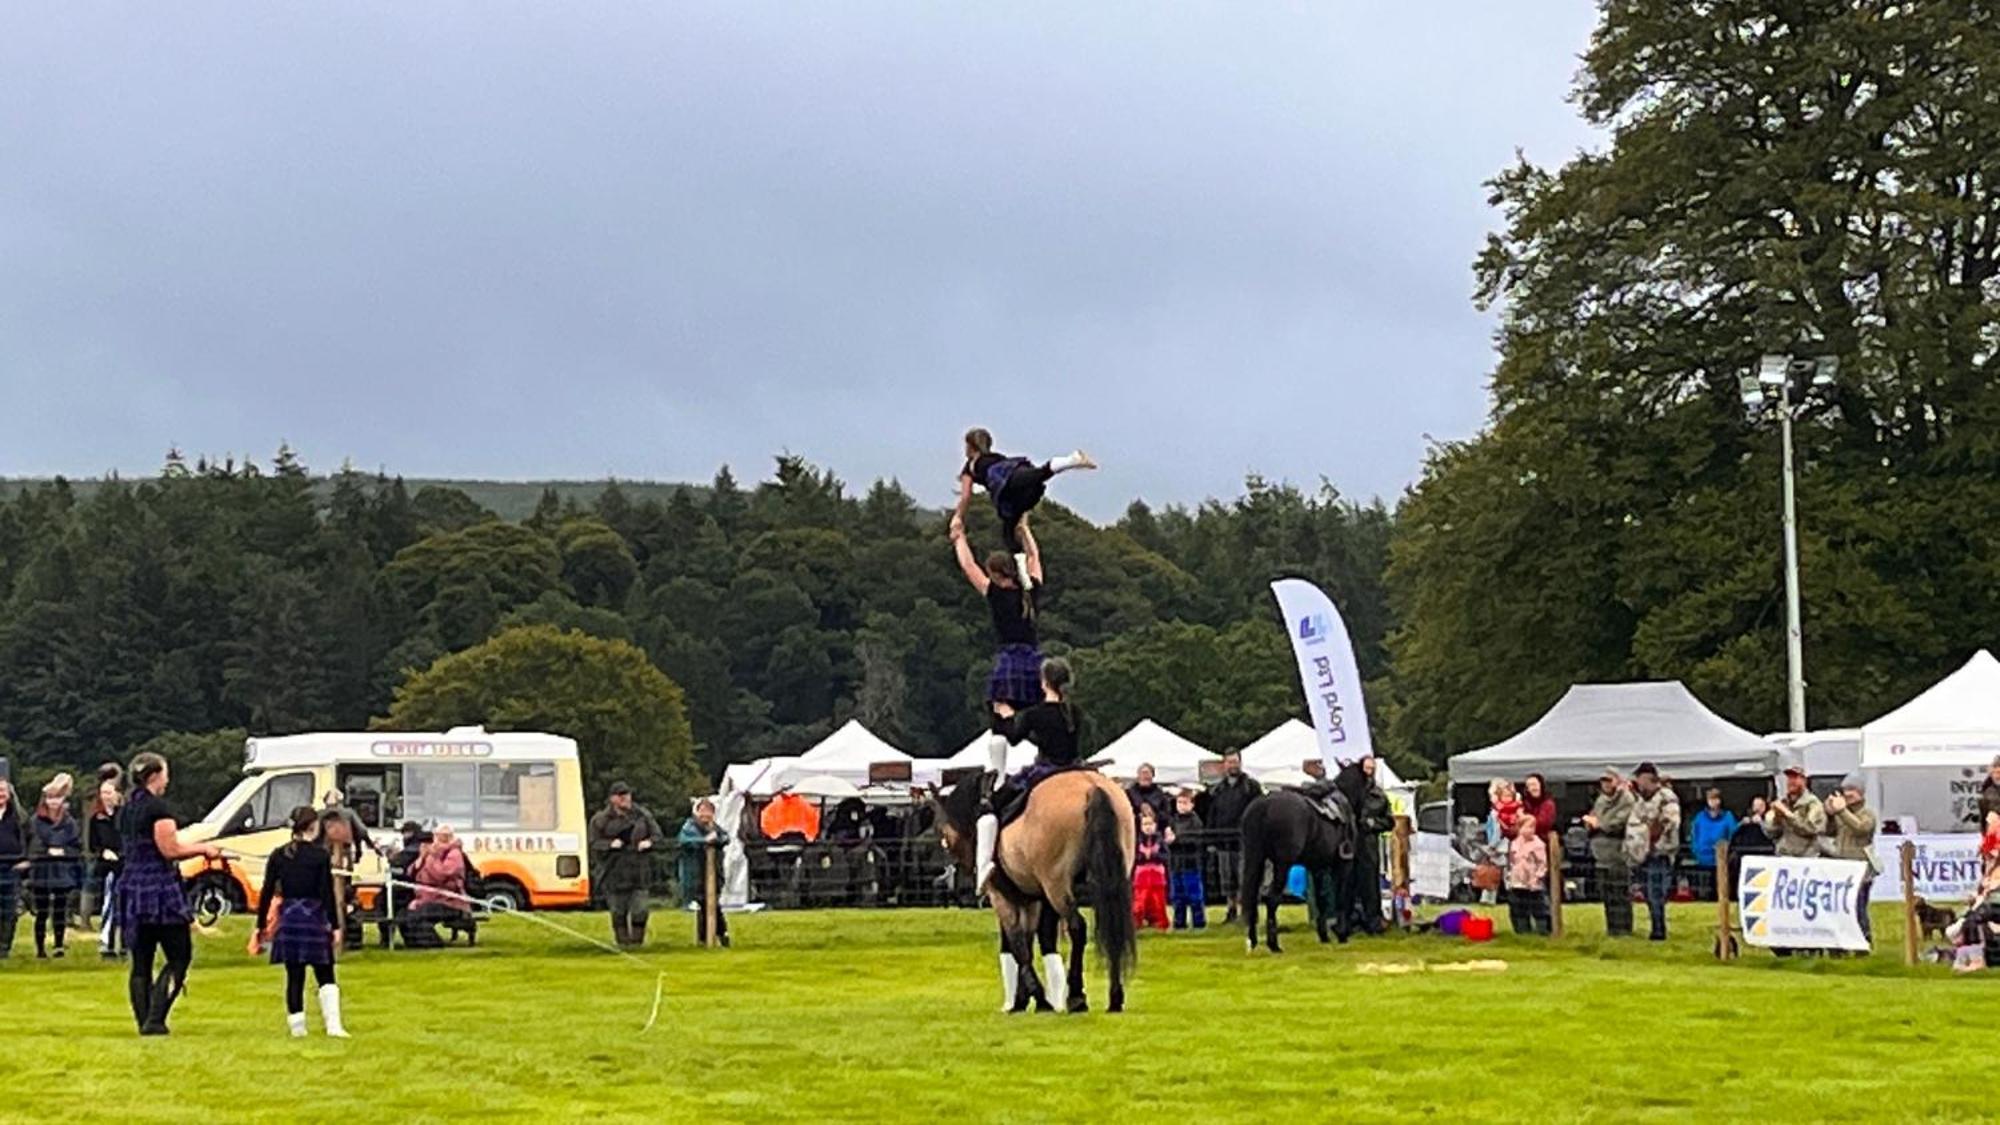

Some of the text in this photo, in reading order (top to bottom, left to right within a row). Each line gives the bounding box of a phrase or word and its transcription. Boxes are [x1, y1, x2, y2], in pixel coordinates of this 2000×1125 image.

[1312, 655, 1335, 689] Ltd
[1321, 691, 1347, 744] Lloyd
[474, 837, 556, 851] DESSERTS
[1772, 867, 1854, 921] Reigart
